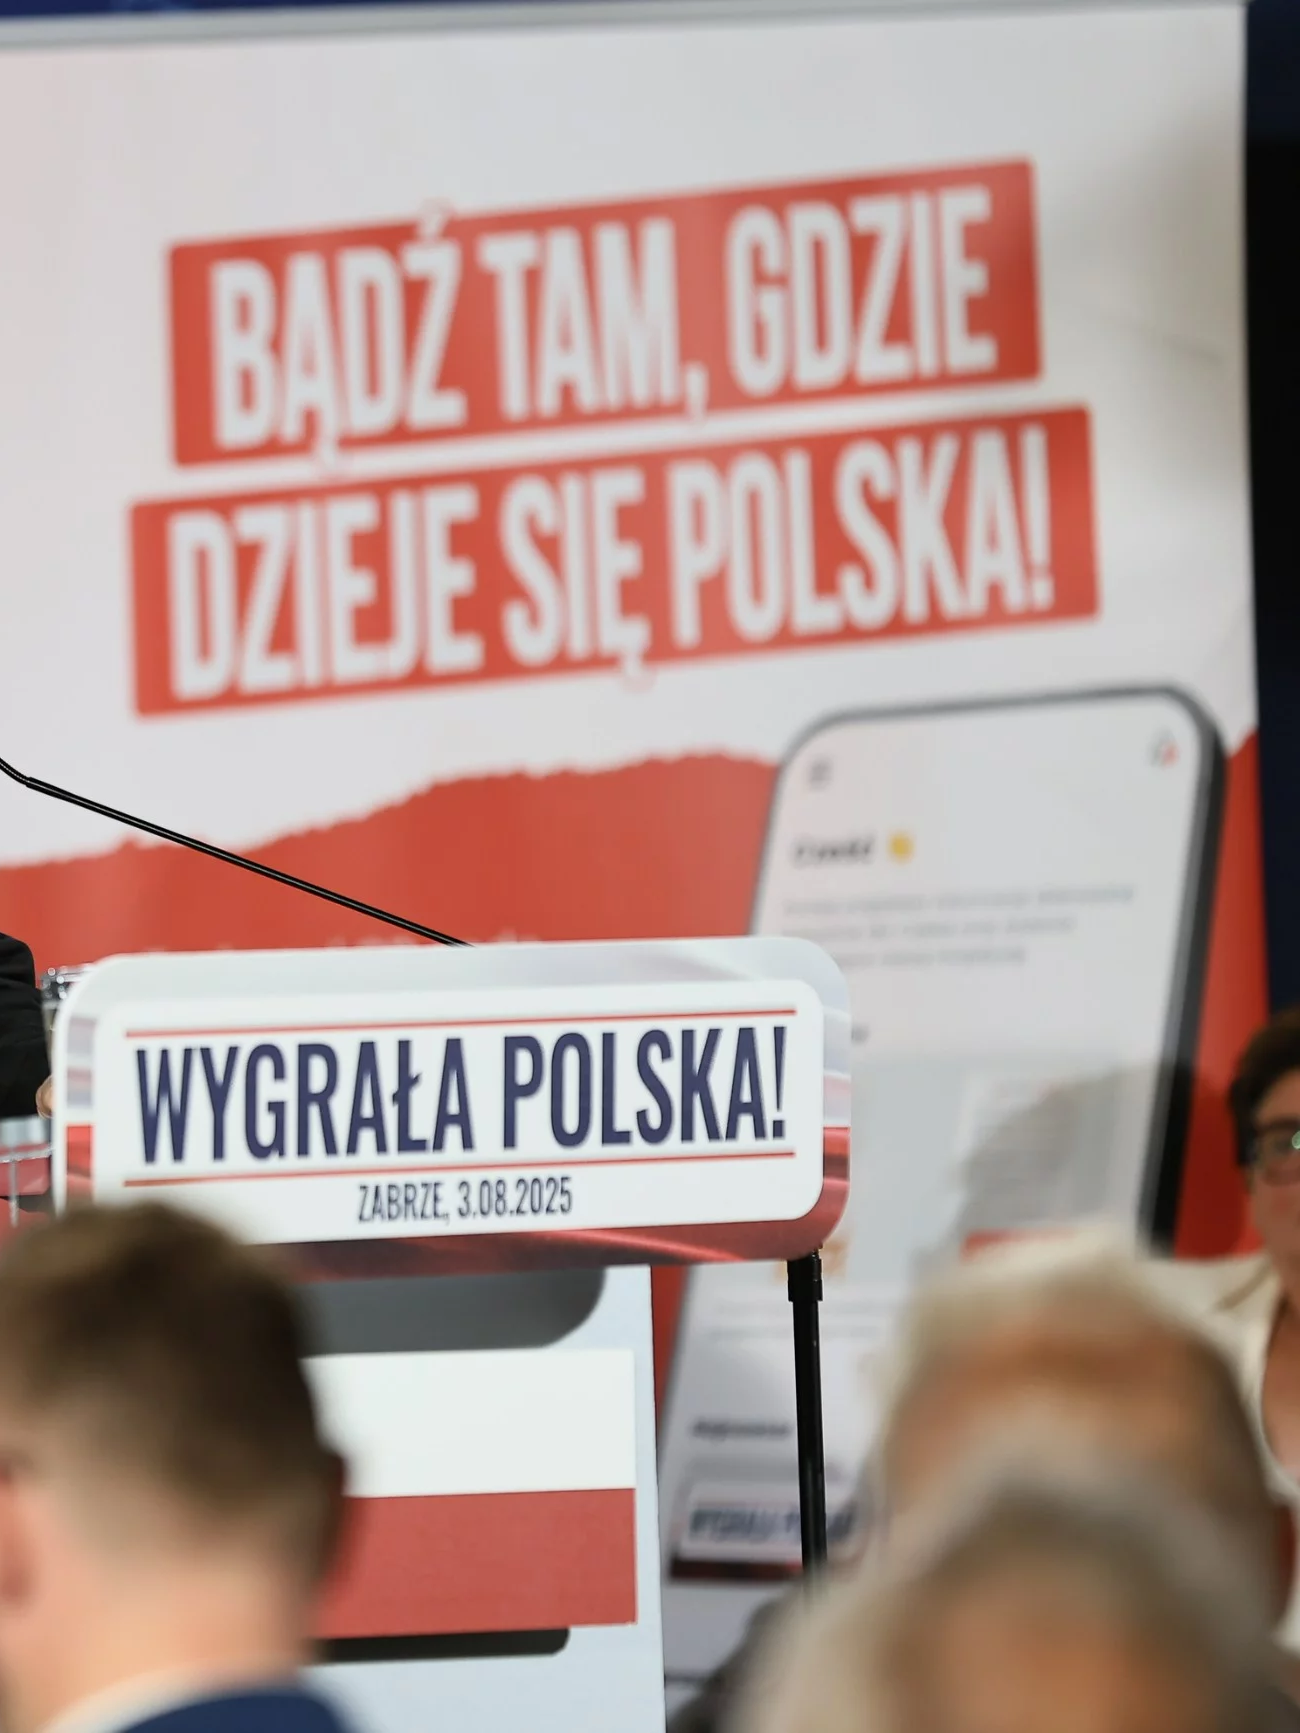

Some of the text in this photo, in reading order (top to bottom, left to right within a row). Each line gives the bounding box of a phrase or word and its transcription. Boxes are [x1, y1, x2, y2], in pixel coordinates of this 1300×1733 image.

[210, 187, 995, 466] BĄDŹ TAM, GDZIE
[168, 424, 1055, 701] DZIEJE SIĘ POLSKA!
[136, 1026, 786, 1164] WYGRAŁA POLSKA!
[357, 1177, 572, 1226] ZABRZE, 3.08.2025
